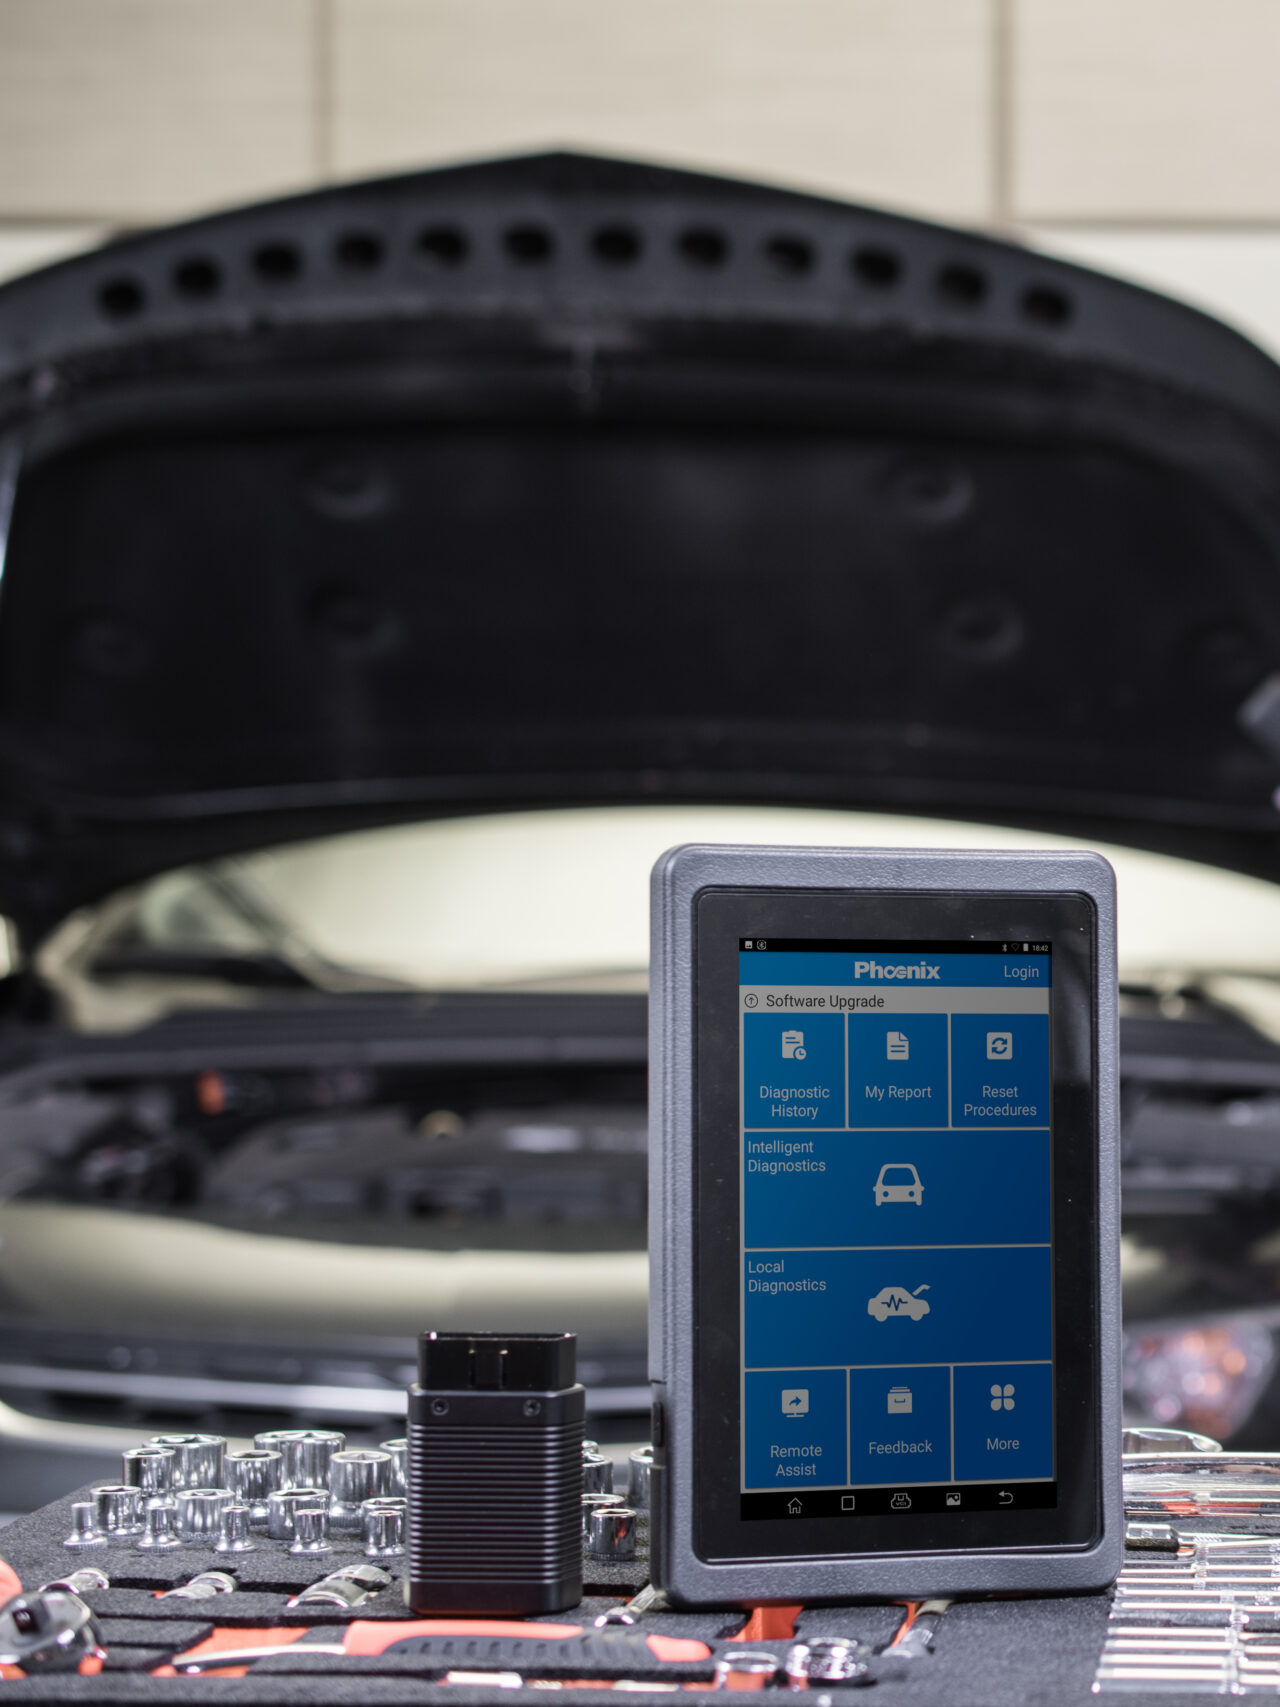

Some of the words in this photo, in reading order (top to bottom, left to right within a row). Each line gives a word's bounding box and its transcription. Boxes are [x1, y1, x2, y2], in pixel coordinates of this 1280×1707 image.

[1004, 965, 1040, 981] Login
[766, 994, 826, 1009] Software
[829, 994, 885, 1011] Upgrade
[759, 1085, 830, 1101] Diagnostic
[865, 1085, 885, 1101] My
[888, 1085, 932, 1101] Report
[982, 1085, 1018, 1098] Reset
[771, 1104, 819, 1121] History
[964, 1103, 1037, 1117] Procedures
[748, 1140, 814, 1156] Intelligent
[748, 1159, 826, 1175] Diagnostics
[748, 1260, 785, 1274] Local
[748, 1279, 827, 1295] Diagnostics
[770, 1444, 822, 1458] Remote
[868, 1440, 933, 1455] Feedback
[986, 1438, 1020, 1451] More
[775, 1463, 817, 1477] Assist
